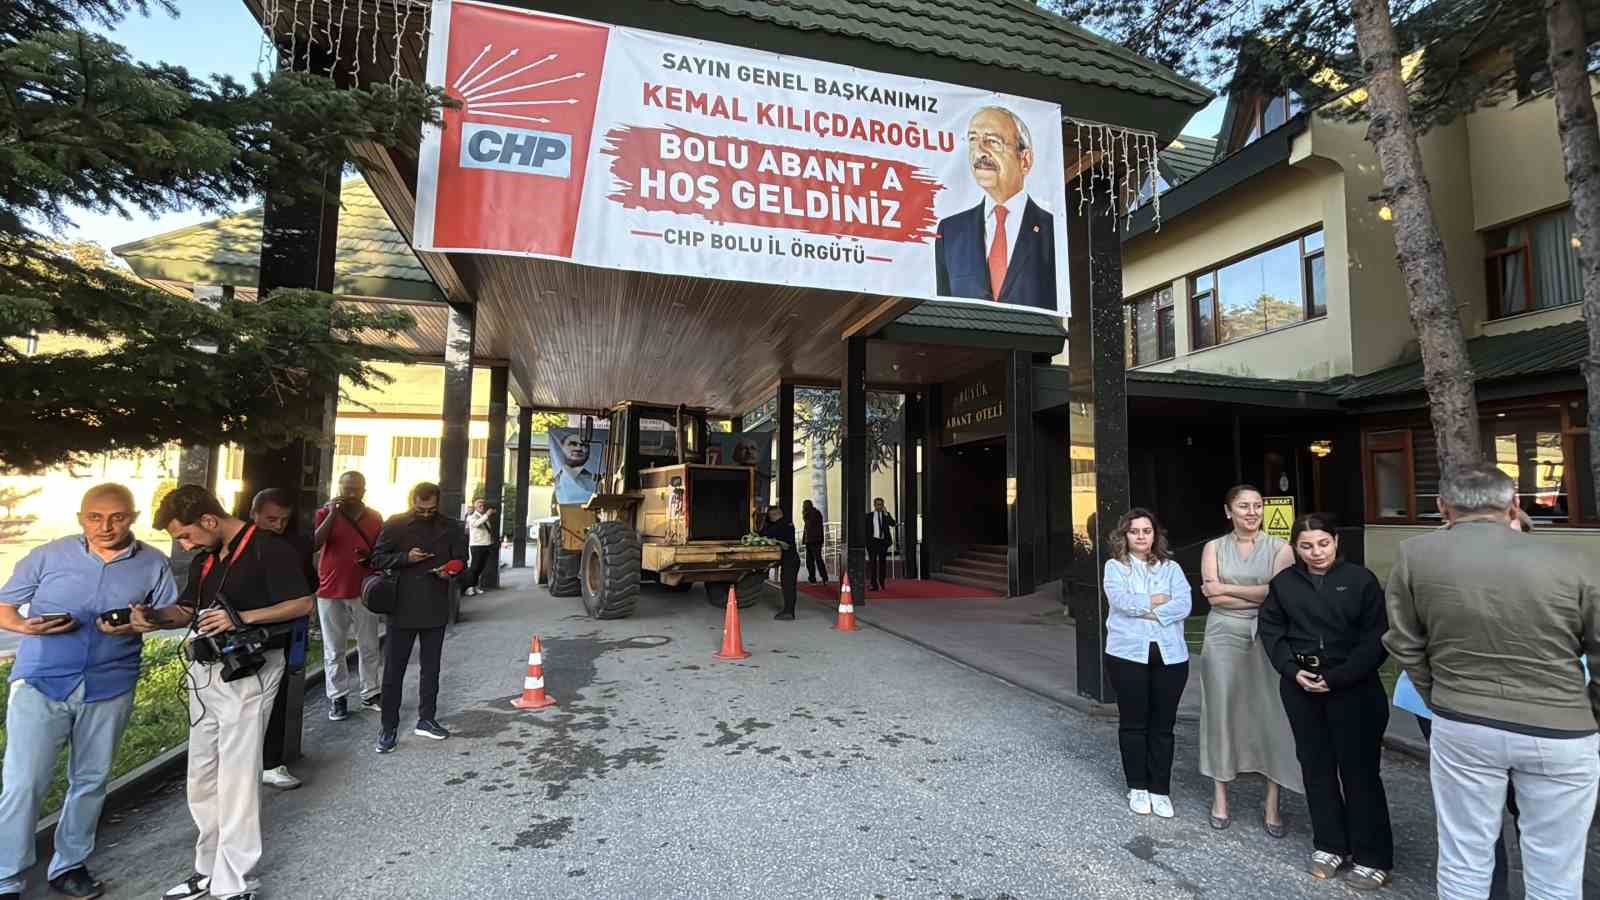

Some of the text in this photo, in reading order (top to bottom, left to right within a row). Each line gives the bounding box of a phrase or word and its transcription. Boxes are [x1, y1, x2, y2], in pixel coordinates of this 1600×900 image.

[662, 52, 939, 114] SAYIN GENEL BAŞKANIMIZ
[642, 82, 955, 153] KEMAL KILIÇDAROĞLU
[468, 129, 567, 168] CHP
[659, 132, 750, 170] BOLU
[639, 167, 902, 229] HOŞ GELDİNİZ
[664, 228, 865, 264] CHP BOLU İL ÖRGÜTÜ
